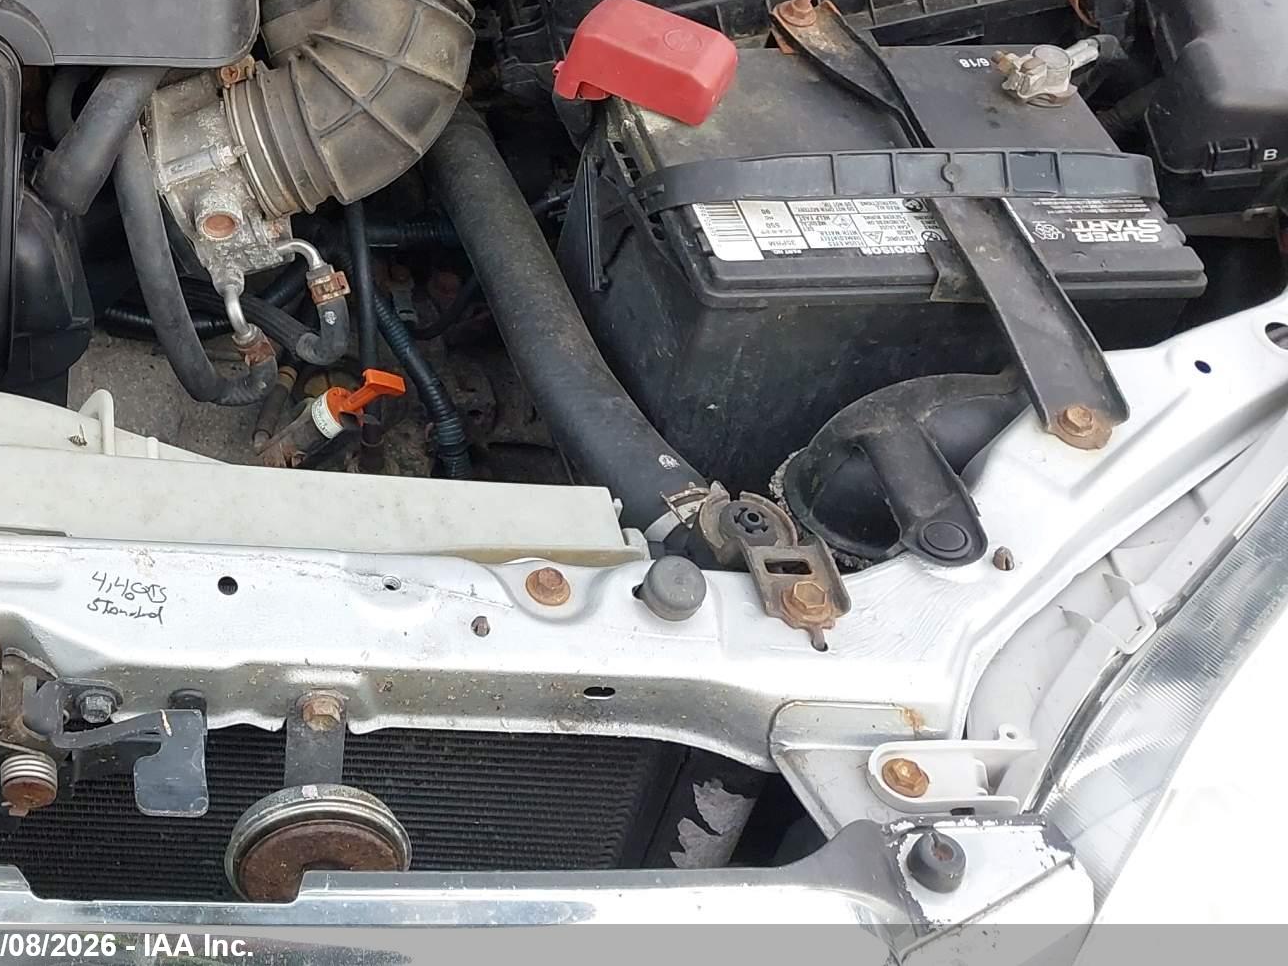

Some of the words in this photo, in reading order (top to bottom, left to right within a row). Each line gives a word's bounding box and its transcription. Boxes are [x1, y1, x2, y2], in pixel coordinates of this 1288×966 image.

[1263, 148, 1279, 161] B
[1072, 217, 1162, 233] START
[1075, 230, 1159, 243] SUPER
[860, 245, 926, 255] R/POISON
